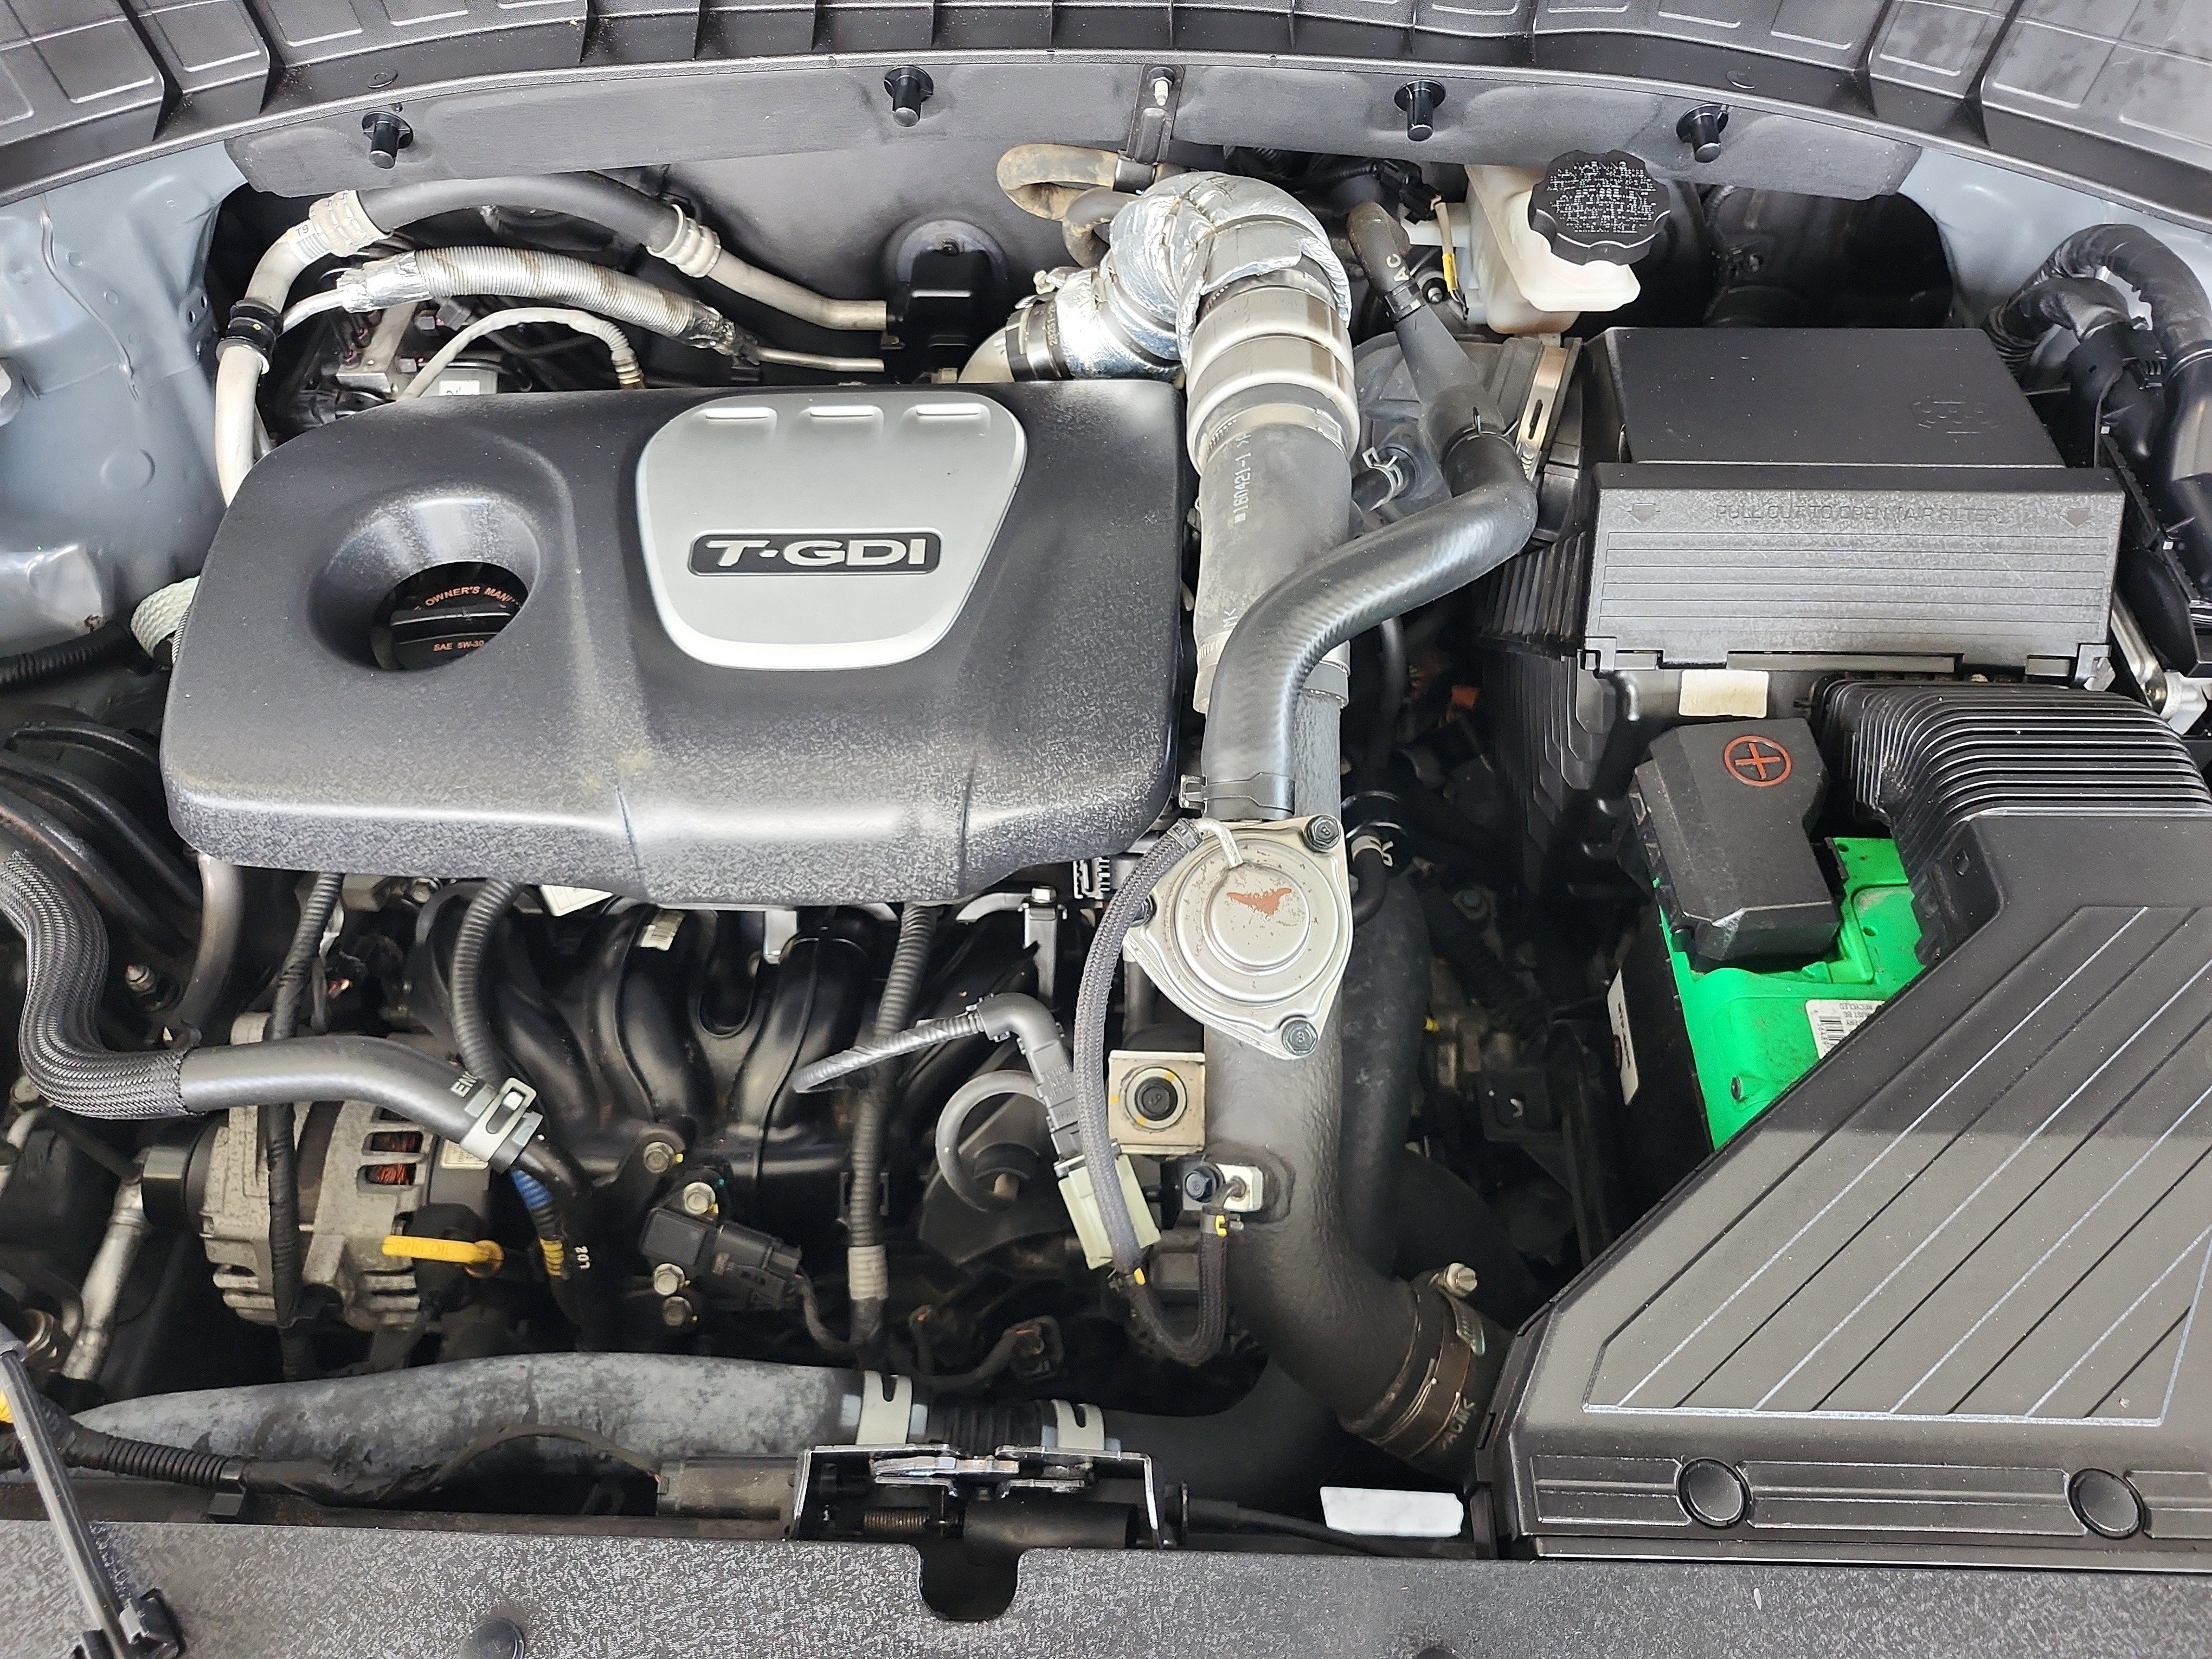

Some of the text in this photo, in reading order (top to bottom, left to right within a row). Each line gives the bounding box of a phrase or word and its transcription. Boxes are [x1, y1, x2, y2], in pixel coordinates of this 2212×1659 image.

[295, 224, 308, 236] T9
[1386, 253, 1410, 281] AC
[425, 586, 481, 606] OWNER'S
[434, 640, 485, 651] SAE 5W-30
